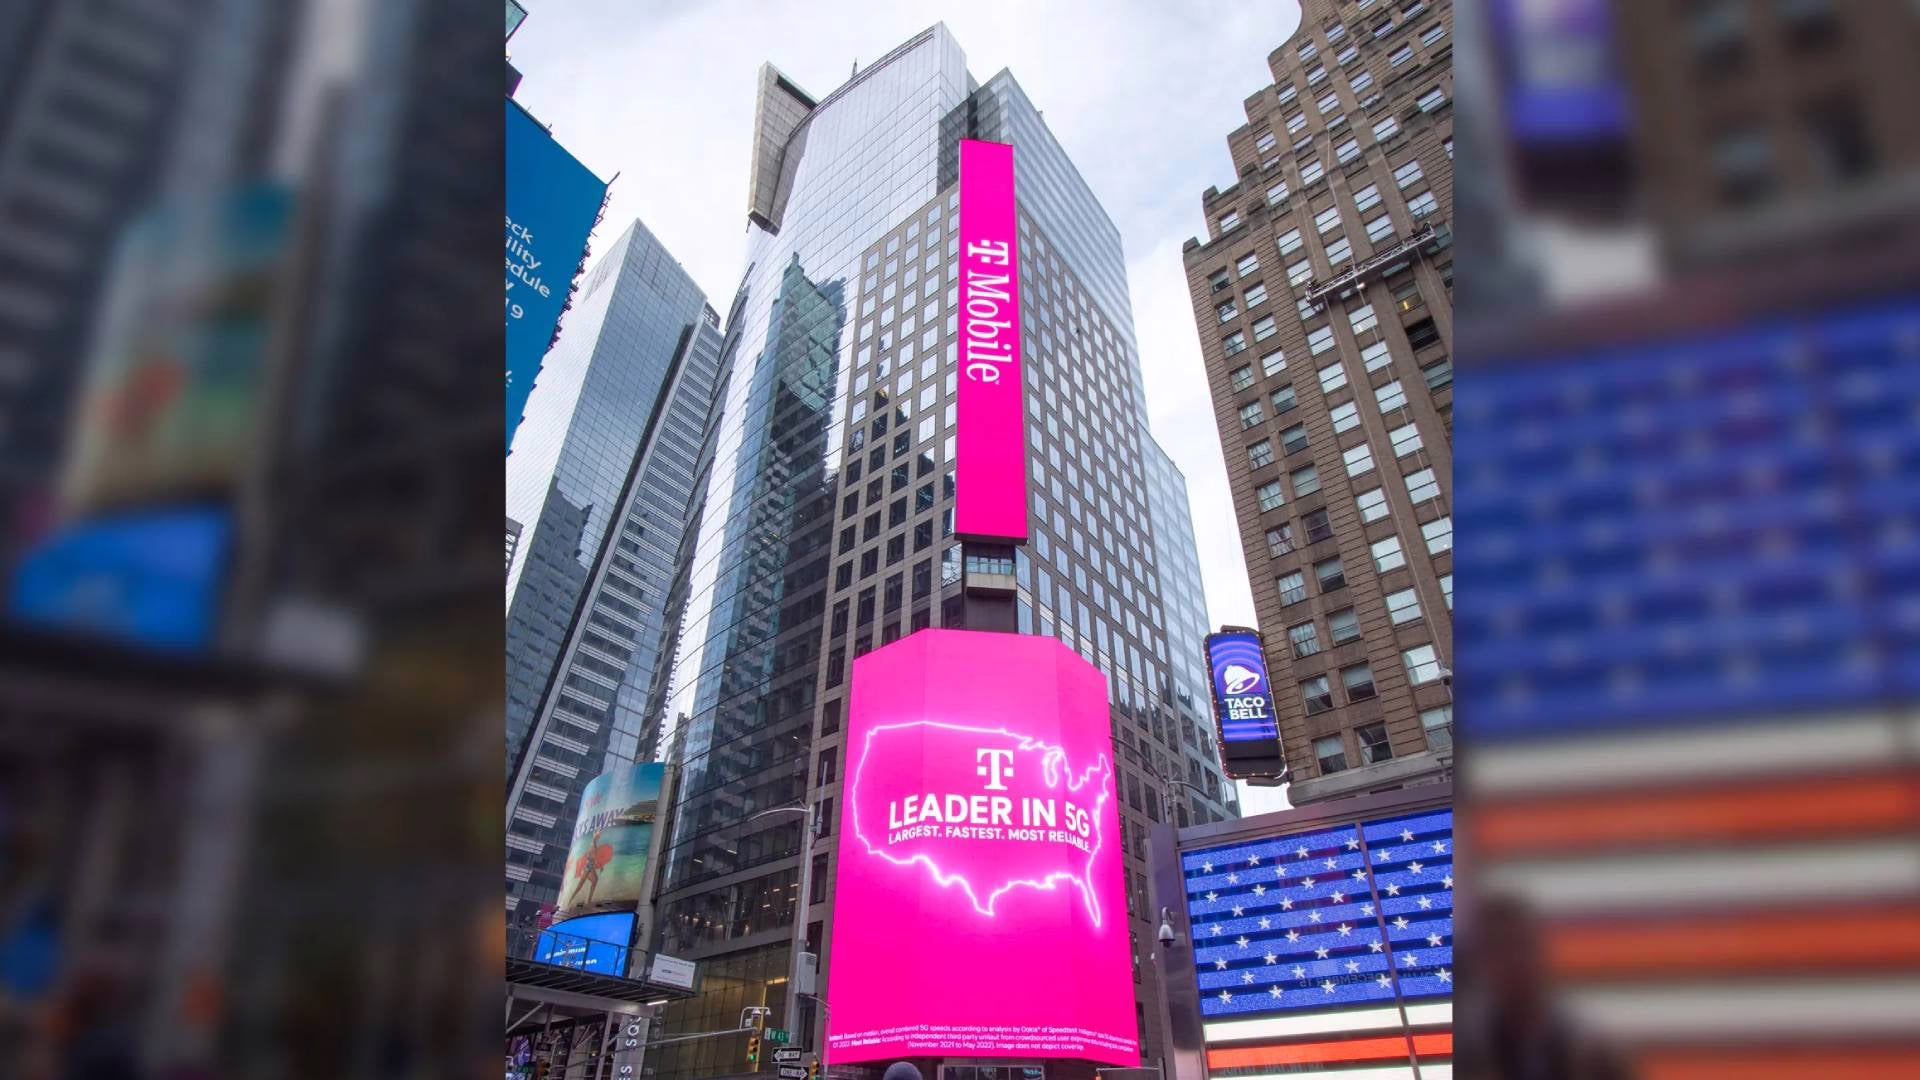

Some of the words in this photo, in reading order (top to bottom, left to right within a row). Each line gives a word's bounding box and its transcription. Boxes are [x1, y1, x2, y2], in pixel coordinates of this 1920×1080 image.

[966, 269, 1012, 384] Mobile
[1224, 697, 1265, 709] TACO
[1230, 708, 1267, 720] BELL
[889, 793, 1013, 829] LEADER
[1021, 797, 1057, 827] IN
[1064, 801, 1090, 838] 5G
[888, 825, 942, 845] LARGEST.
[945, 828, 1006, 840] FASTEST.
[1008, 828, 1047, 842] MOST
[962, 1034, 978, 1042] party
[963, 1041, 976, 1051] May
[1042, 1043, 1061, 1051] depict
